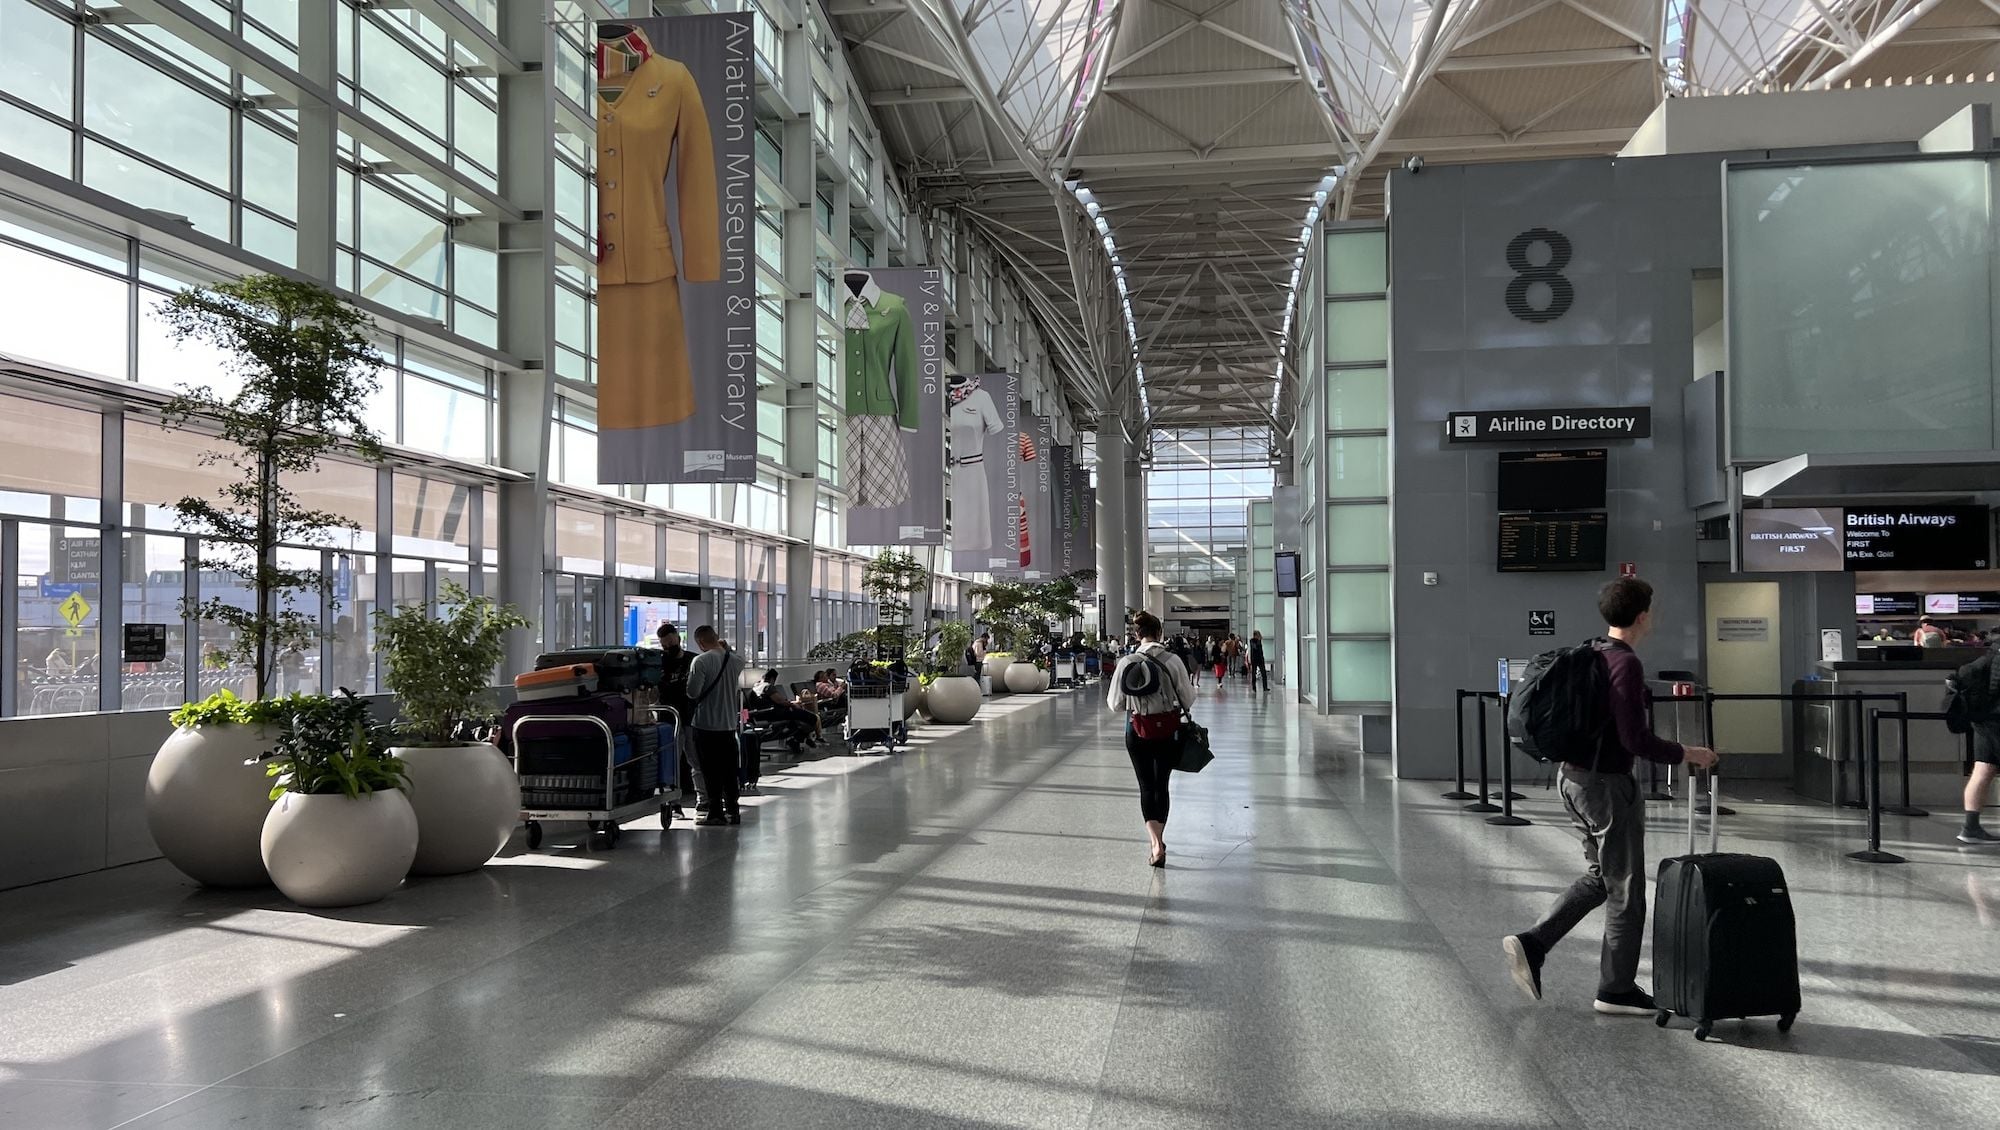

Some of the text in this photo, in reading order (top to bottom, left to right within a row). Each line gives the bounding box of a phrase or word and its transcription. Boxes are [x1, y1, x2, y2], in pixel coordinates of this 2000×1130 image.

[720, 18, 753, 430] Aviation Museum & Library
[1504, 227, 1575, 323] 8
[919, 269, 941, 395] Fly & Explore
[1006, 374, 1018, 429] Aviation
[1488, 414, 1636, 432] Airline Directory
[725, 453, 754, 461] Museum
[1006, 432, 1018, 490] Museum
[1037, 416, 1050, 494] Fly & Explore
[1063, 446, 1073, 487] Aviation
[1007, 493, 1019, 502] &
[1063, 488, 1073, 530] Museum
[1006, 505, 1019, 551] Library
[1783, 532, 1819, 540] AIRWAYS
[1846, 513, 1957, 527] British Airways
[1846, 530, 1890, 538] Welcome To
[59, 540, 68, 550] 3
[1062, 540, 1073, 576] Library
[1779, 545, 1807, 553] FIRST
[1846, 540, 1870, 548] FIRST
